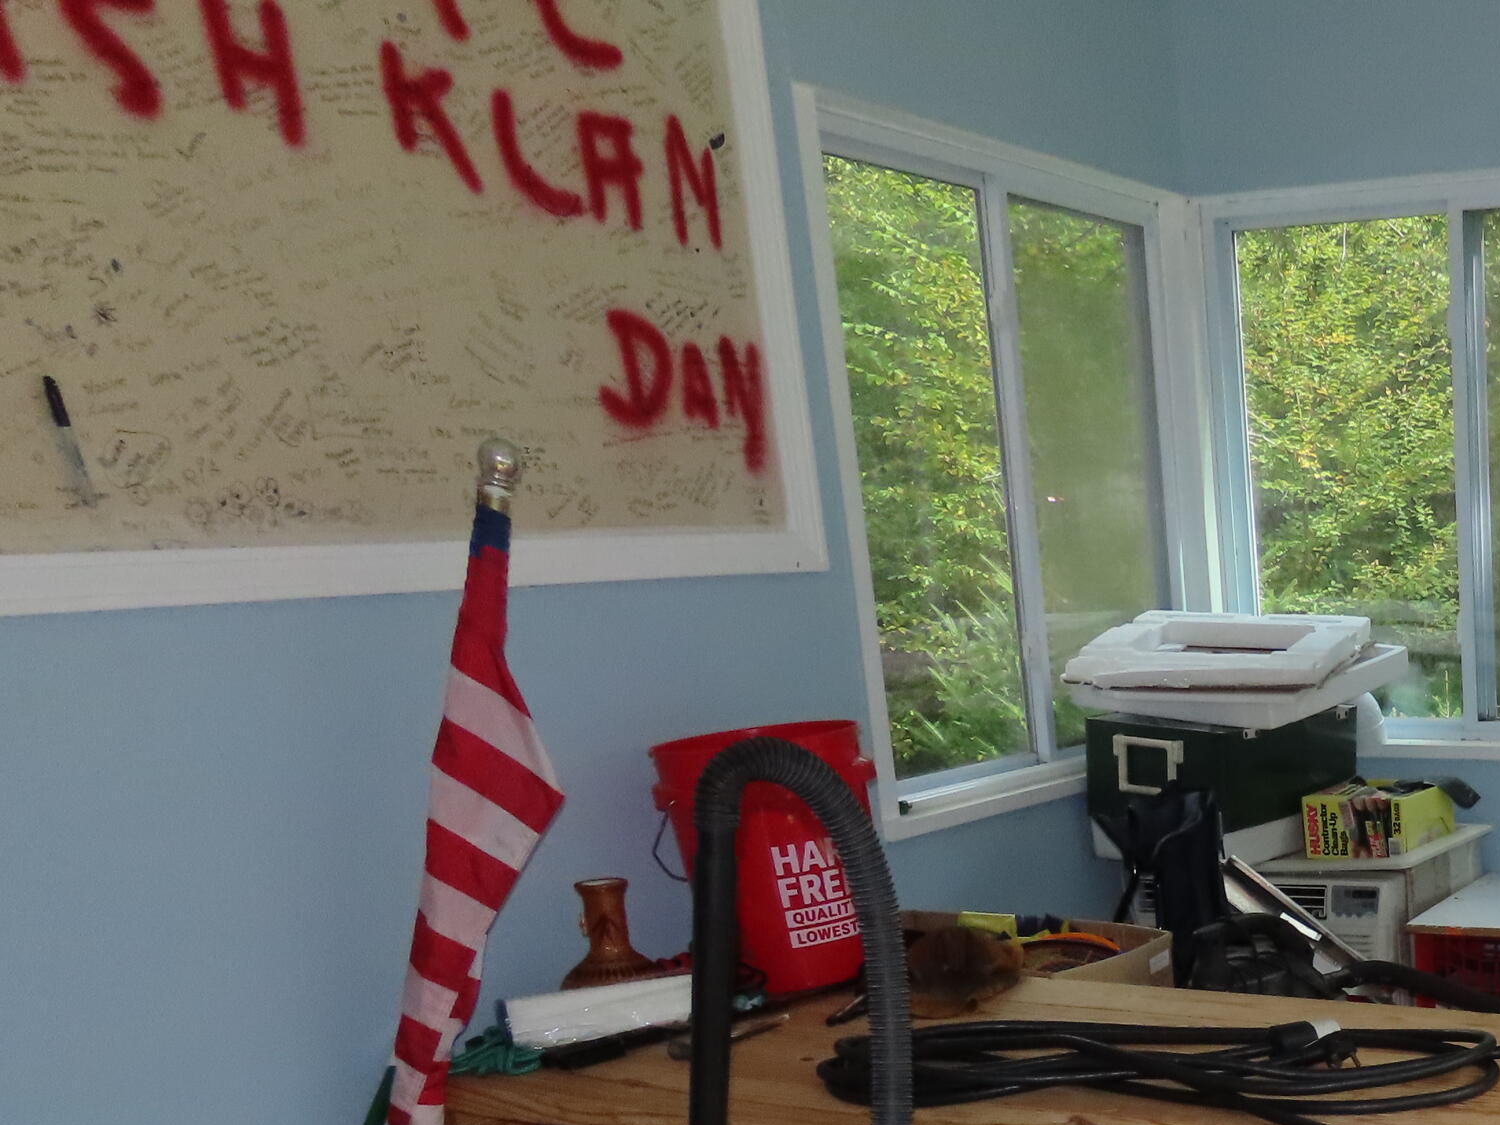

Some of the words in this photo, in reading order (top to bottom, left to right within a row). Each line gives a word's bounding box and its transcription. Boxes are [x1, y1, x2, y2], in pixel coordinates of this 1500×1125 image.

[0, 0, 304, 147] SH
[378, 40, 723, 249] KLAN
[598, 308, 766, 478] DAN
[1306, 804, 1321, 856] HUSKY
[1320, 803, 1331, 856] Contractor
[1328, 812, 1338, 856] Clean-Up
[1393, 821, 1401, 835] 32
[793, 901, 851, 925] QUALIT
[797, 920, 858, 945] LOWEST
